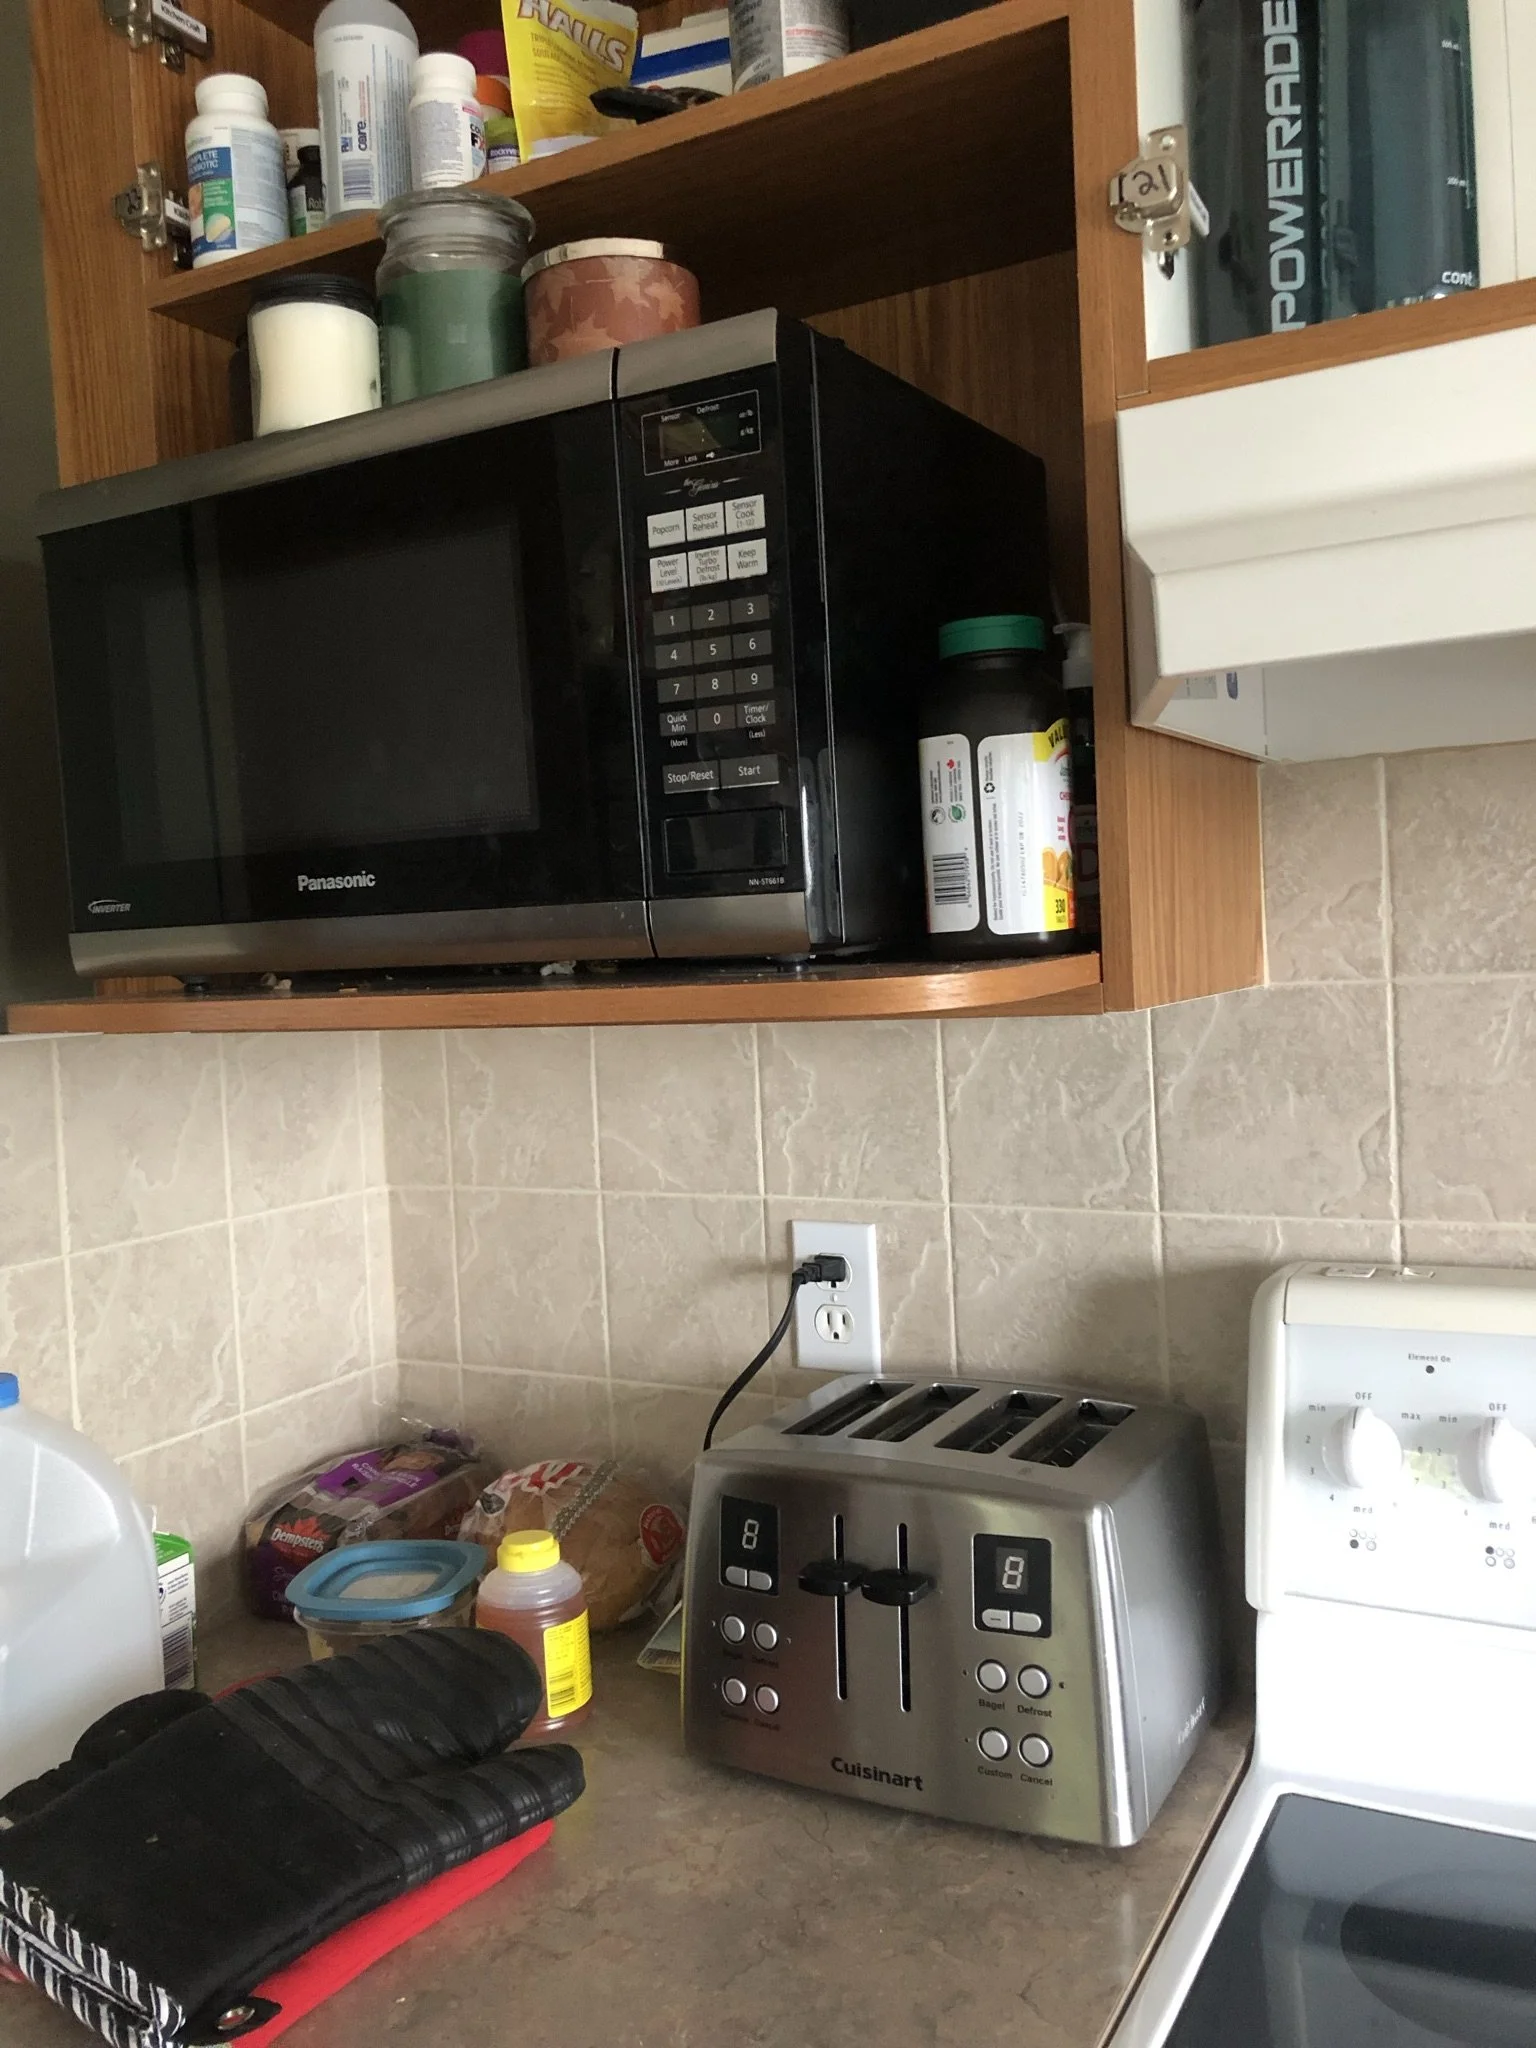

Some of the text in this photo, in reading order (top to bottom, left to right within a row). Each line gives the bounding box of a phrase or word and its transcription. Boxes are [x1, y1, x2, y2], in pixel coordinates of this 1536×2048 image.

[517, 0, 628, 73] HALLS
[357, 121, 367, 151] care
[1263, 0, 1306, 333] POWERADE
[697, 403, 720, 414] Defrost
[661, 412, 681, 423] Sensor
[664, 458, 680, 467] More
[732, 500, 757, 512] Sensor
[692, 511, 717, 522] Sensor
[735, 509, 755, 519] Cook
[652, 524, 680, 536] Popcorn
[692, 520, 719, 531] Reheat
[695, 549, 720, 559] Inverter
[738, 549, 757, 561] Keep
[657, 559, 679, 568] Power
[698, 557, 717, 566] Turbo
[736, 559, 759, 570] Warm
[660, 567, 678, 577] Level
[696, 564, 721, 574] Defrost
[708, 609, 715, 621] 2
[747, 603, 754, 615] 3
[670, 615, 675, 627] 1
[710, 644, 717, 656] 5
[749, 638, 756, 650] 6
[670, 649, 677, 661] 4
[712, 678, 719, 690] 8
[751, 673, 758, 685] 9
[673, 684, 680, 696] 7
[743, 703, 769, 715] Timer/
[667, 714, 688, 726] Quick
[713, 713, 721, 725] 0
[745, 713, 766, 724] Clock
[671, 723, 686, 733] Min
[667, 769, 714, 784] Stop/Reset
[738, 765, 761, 777] Start
[298, 871, 376, 892] Panasonic
[1408, 1353, 1451, 1363] Element On
[1355, 1392, 1372, 1401] OFF
[1308, 1403, 1326, 1412] min
[1489, 1403, 1508, 1412] OFF
[1401, 1412, 1421, 1421] max
[1439, 1414, 1458, 1423] min
[1305, 1435, 1311, 1444] 2
[1489, 1521, 1511, 1531] med
[271, 1527, 324, 1552] Dempster's
[978, 1698, 1053, 1718] Bagel Defrost
[831, 1756, 924, 1791] Cuisinart
[978, 1766, 1053, 1787] Custom Cancel
